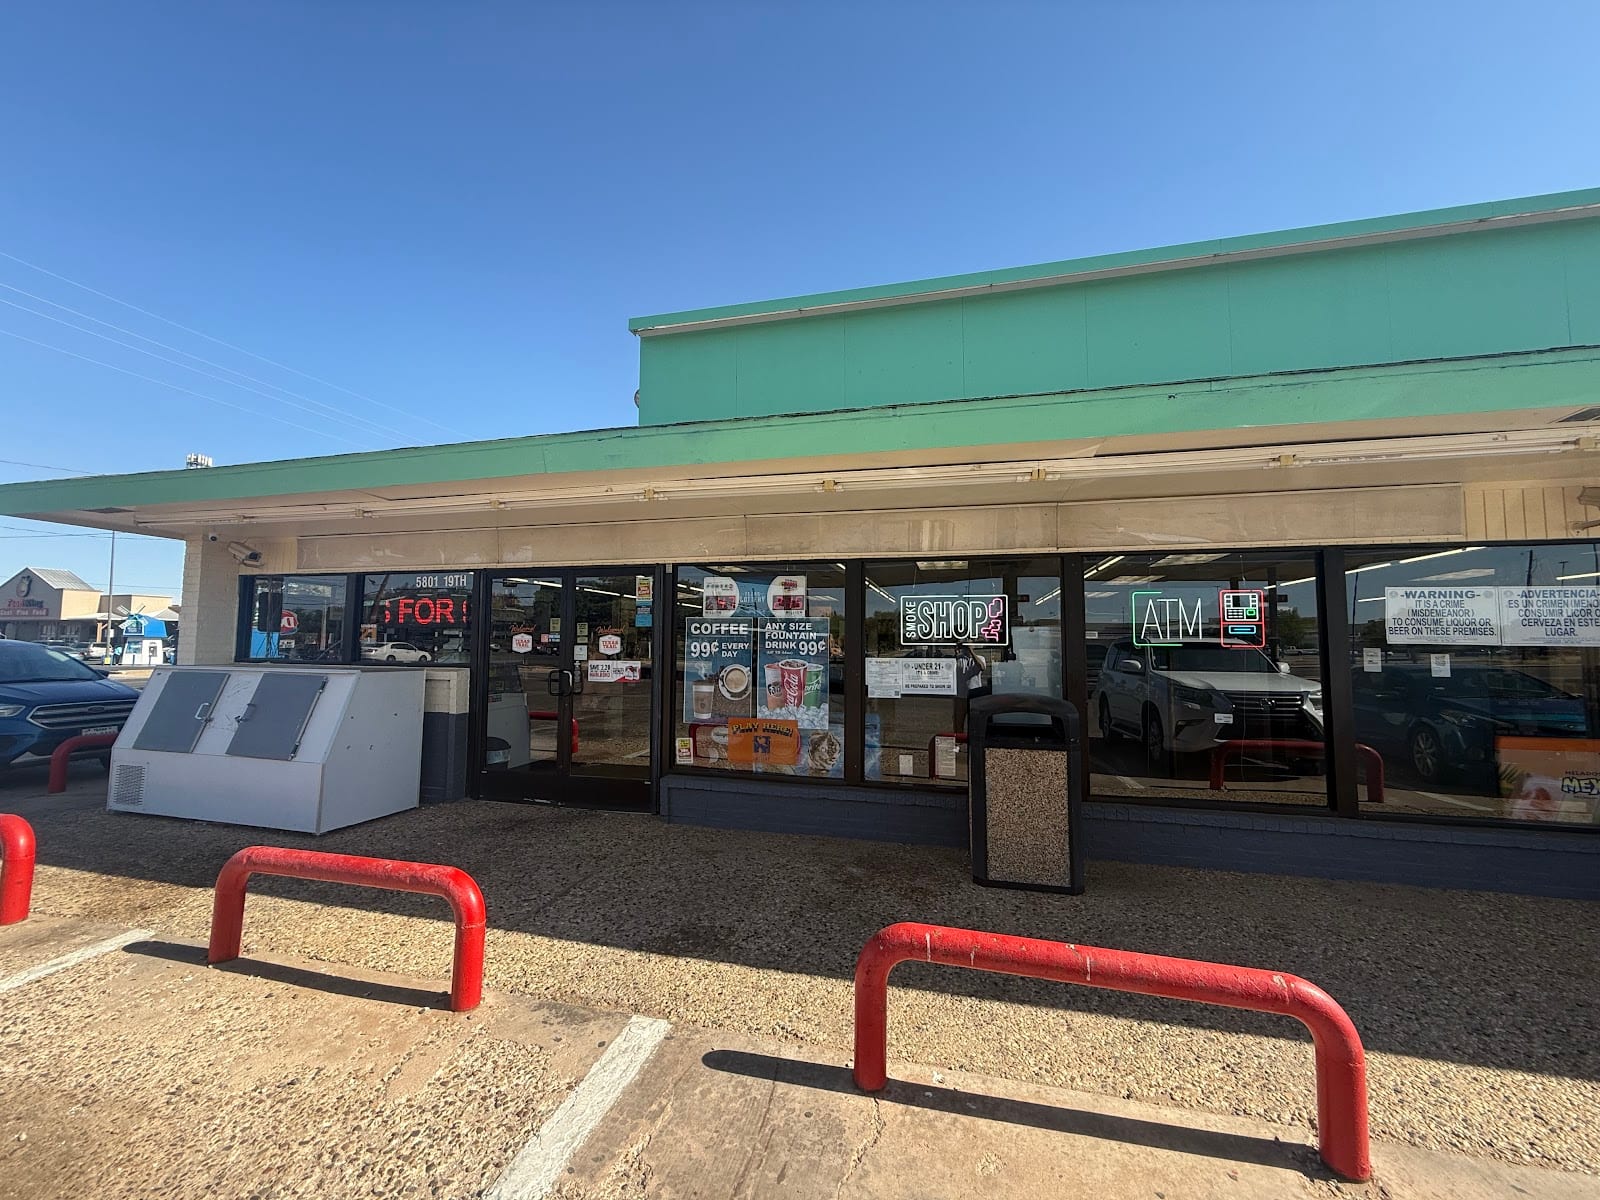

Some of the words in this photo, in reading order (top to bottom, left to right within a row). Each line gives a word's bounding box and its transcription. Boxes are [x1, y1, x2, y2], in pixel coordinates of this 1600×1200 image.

[416, 576, 438, 588] 5801
[443, 575, 467, 587] 19TH
[1415, 600, 1422, 608] IT
[1424, 600, 1431, 608] IS
[1433, 600, 1438, 608] A
[1440, 600, 1465, 608] CRIME
[1508, 600, 1519, 608] ES
[1522, 600, 1534, 608] UN
[1536, 600, 1568, 608] CRIMEN
[398, 597, 455, 625] FOR
[1518, 609, 1563, 617] CONSUMIR
[1567, 609, 1592, 617] LICOR
[906, 601, 916, 637] SMOKE
[918, 601, 988, 639] SHOP
[1141, 598, 1203, 640] ATM
[1392, 618, 1402, 626] TO
[1404, 618, 1444, 626] CONSUME
[1446, 618, 1476, 626] LIQUOR
[1479, 618, 1491, 626] OR
[1521, 618, 1561, 626] CERVEZA
[1564, 618, 1575, 626] EN
[1578, 618, 1600, 626] ESTE
[690, 623, 748, 635] COFFEE
[1389, 627, 1409, 635] BEER
[1411, 627, 1423, 635] ON
[1425, 627, 1451, 635] THESE
[1453, 627, 1497, 636] PREMISES.
[1545, 628, 1578, 636] LUGAR.
[765, 631, 816, 640] FOUNTAIN
[690, 640, 719, 657] 99¢
[765, 641, 797, 649] DRINK
[798, 638, 826, 655] 99¢
